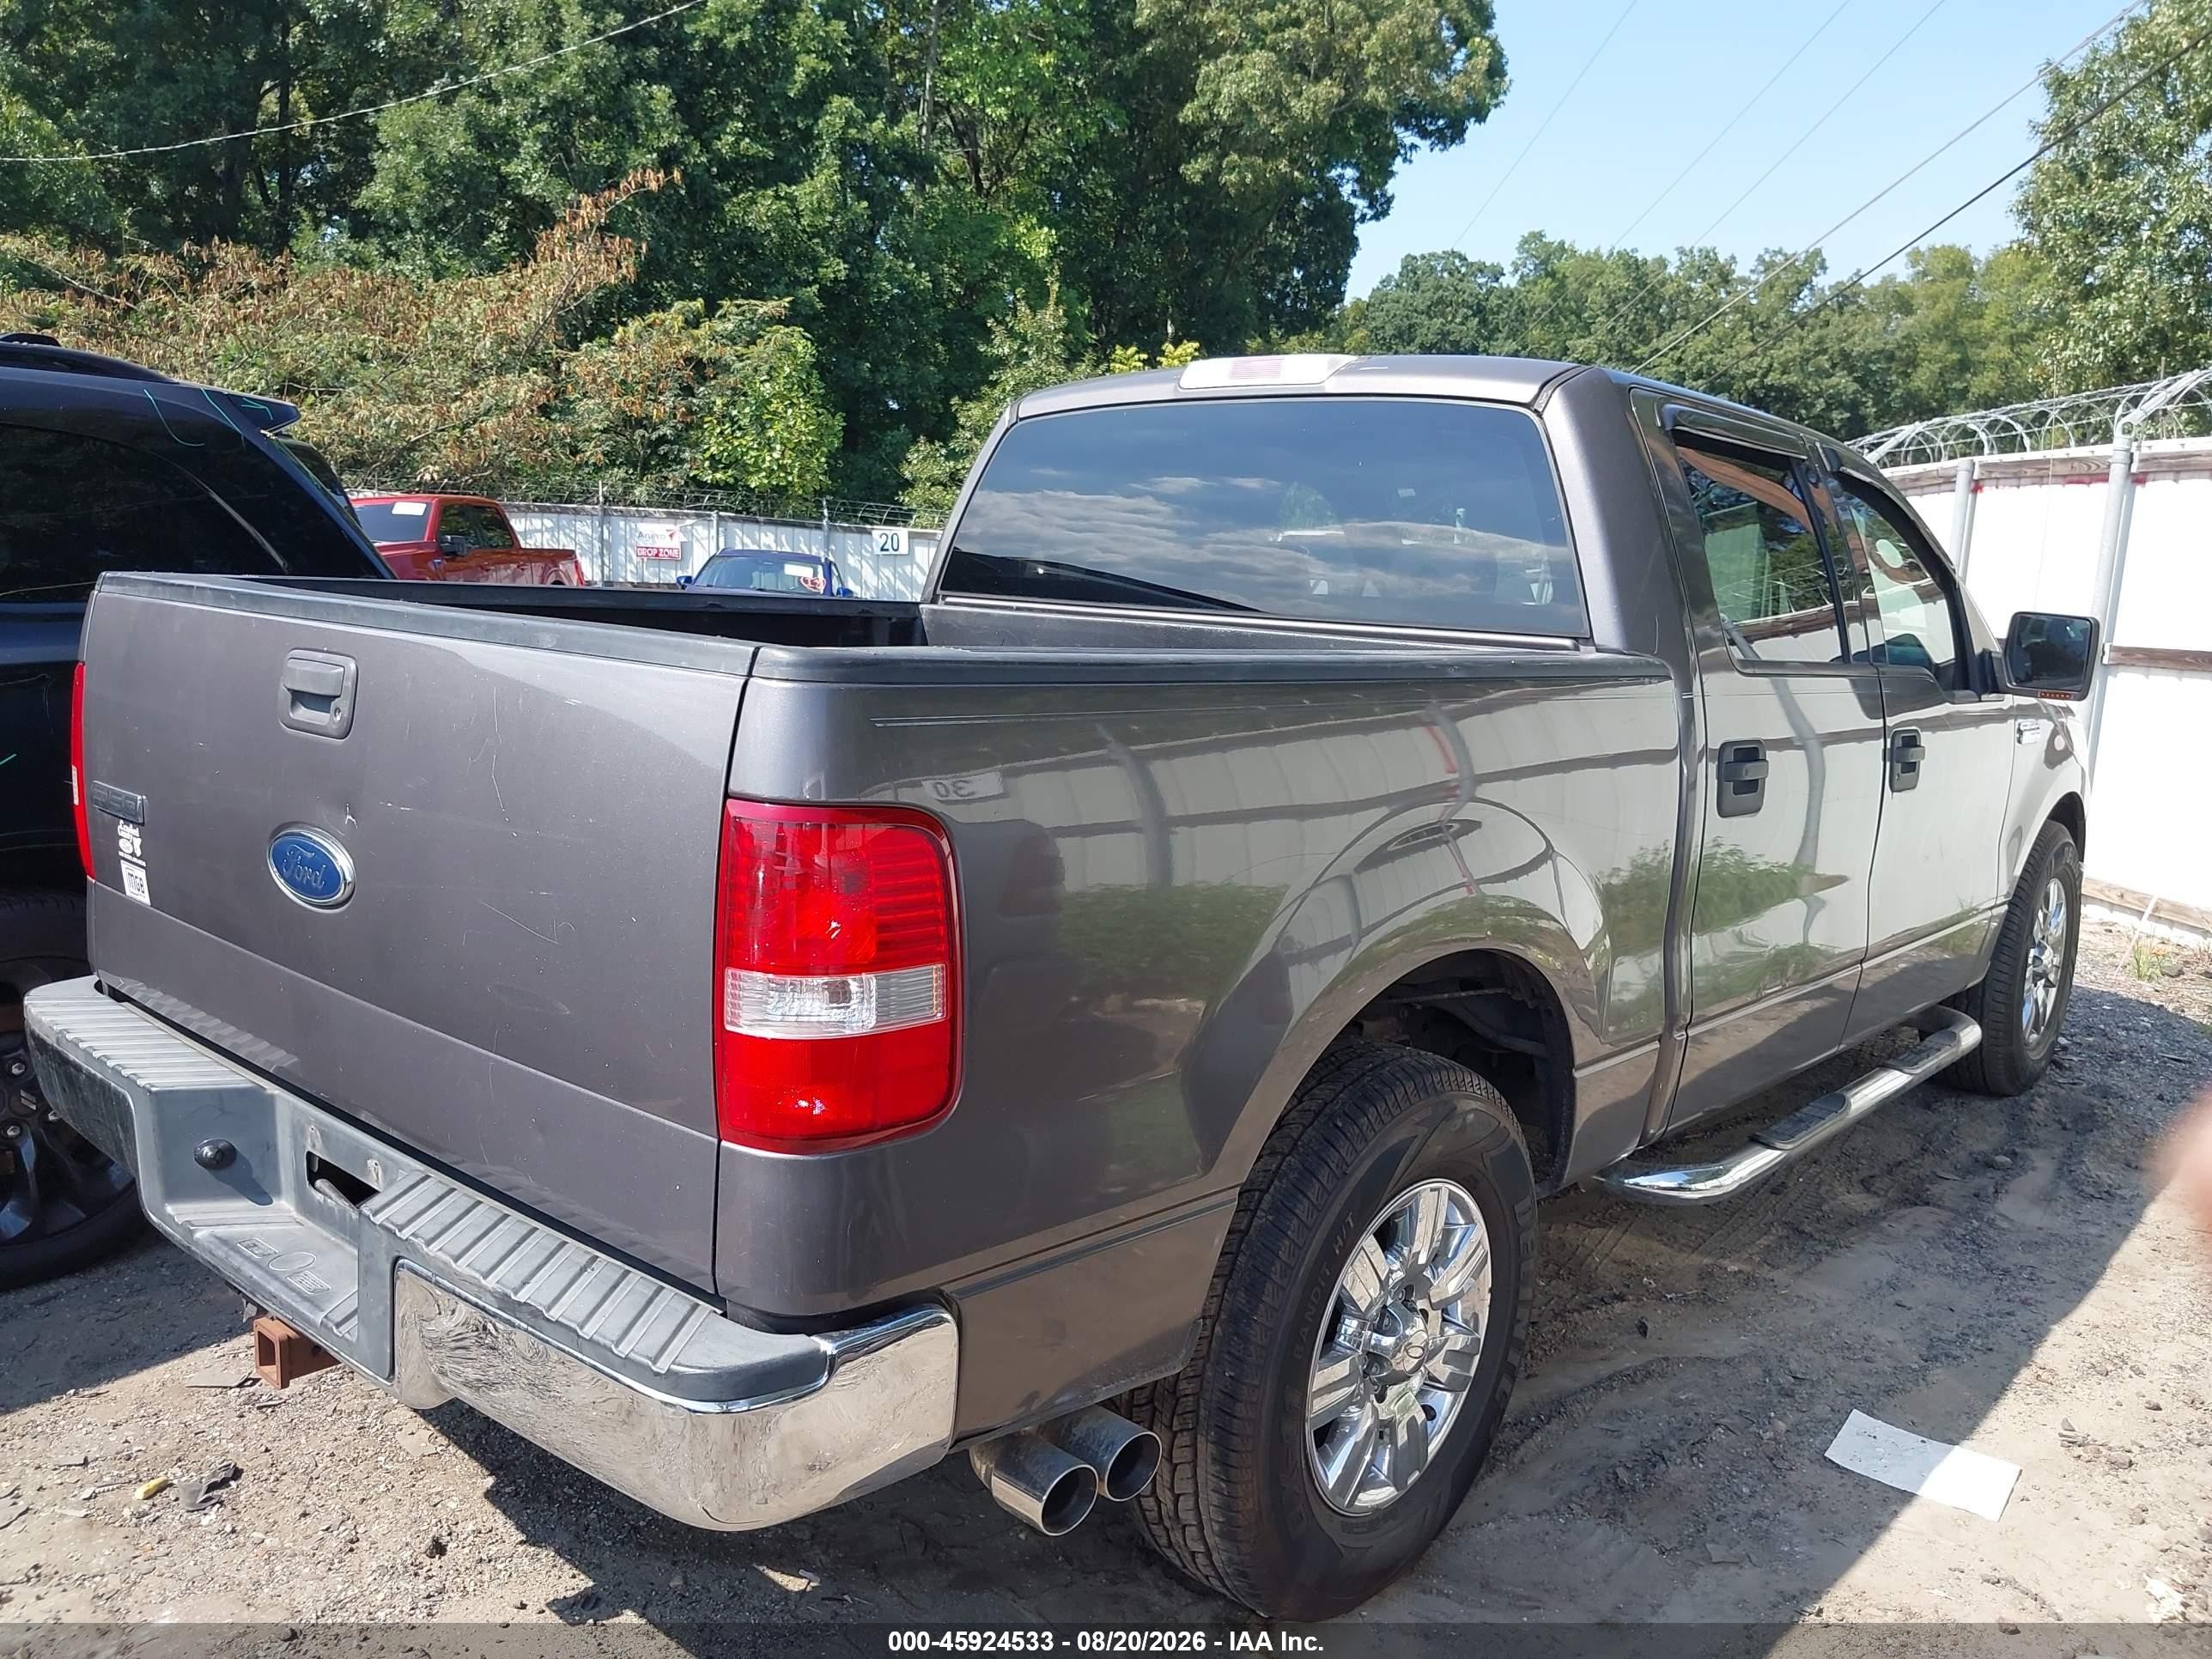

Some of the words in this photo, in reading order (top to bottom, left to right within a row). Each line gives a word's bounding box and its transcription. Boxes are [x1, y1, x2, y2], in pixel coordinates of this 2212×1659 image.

[637, 548, 658, 556] DROP
[659, 549, 679, 558] ZONE
[879, 532, 899, 551] 20
[283, 844, 327, 889] Ford
[1293, 1262, 1331, 1359] BANDIT
[1333, 1212, 1353, 1255] H/T
